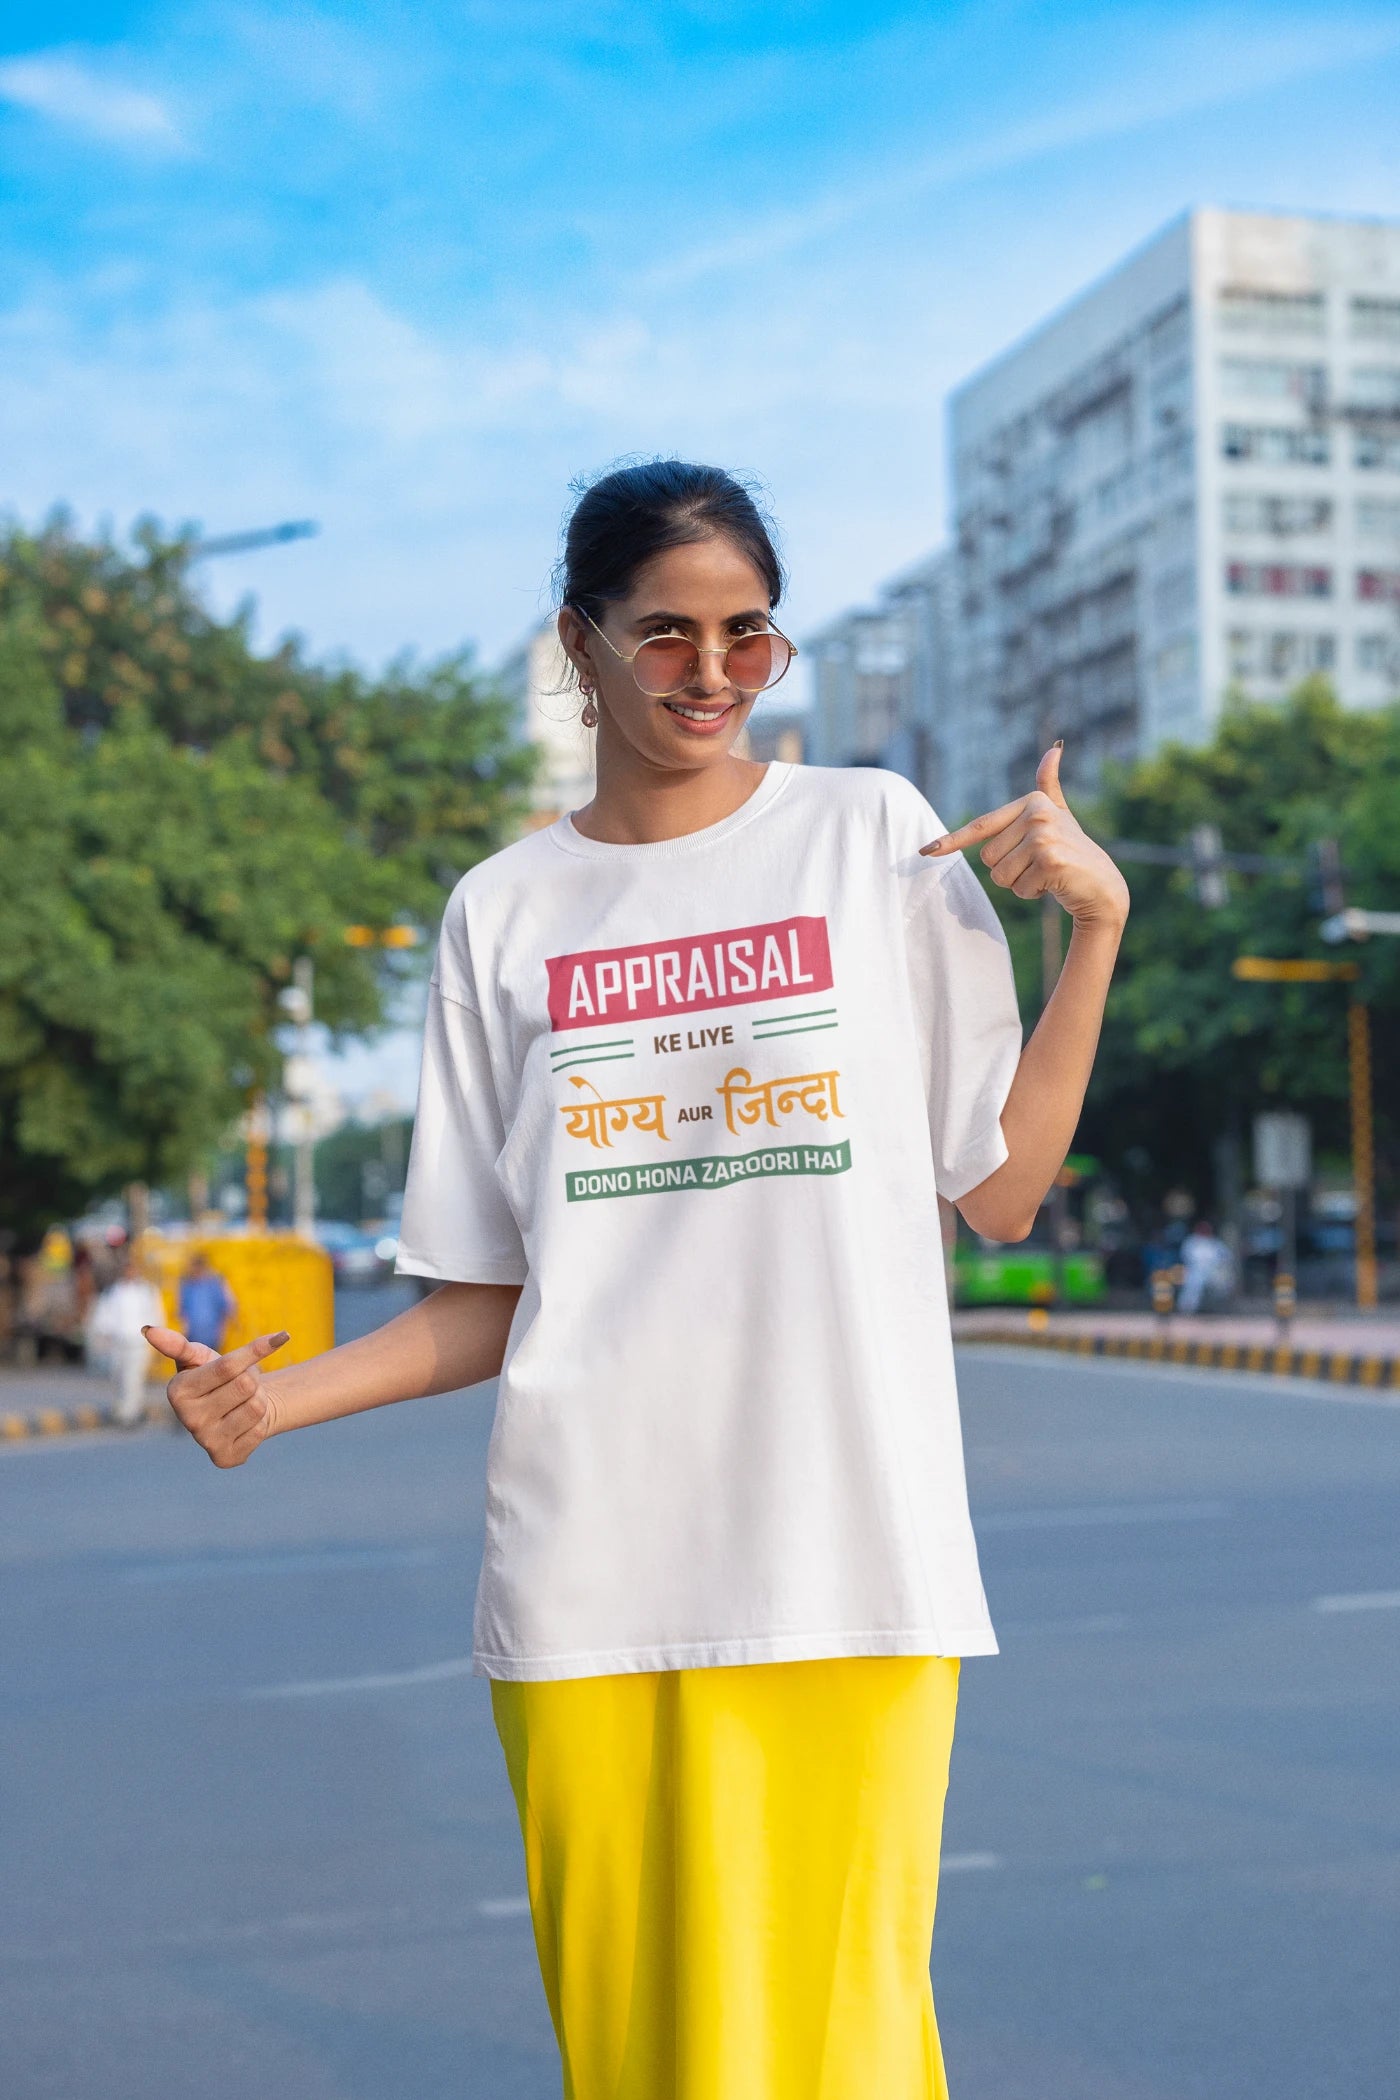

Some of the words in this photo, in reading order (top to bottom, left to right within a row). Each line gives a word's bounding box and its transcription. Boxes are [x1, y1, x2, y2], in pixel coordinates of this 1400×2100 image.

[568, 928, 814, 1019] APPRAISAL
[653, 1032, 683, 1055] KE
[687, 1025, 734, 1050] LIYE
[559, 1075, 672, 1149] योग्य
[677, 1105, 714, 1124] AUR
[715, 1066, 847, 1137] जिन्दा
[574, 1171, 631, 1196] DONO
[636, 1164, 697, 1190] HONA
[701, 1150, 800, 1184] ZAROORI
[803, 1149, 842, 1170] HAI
